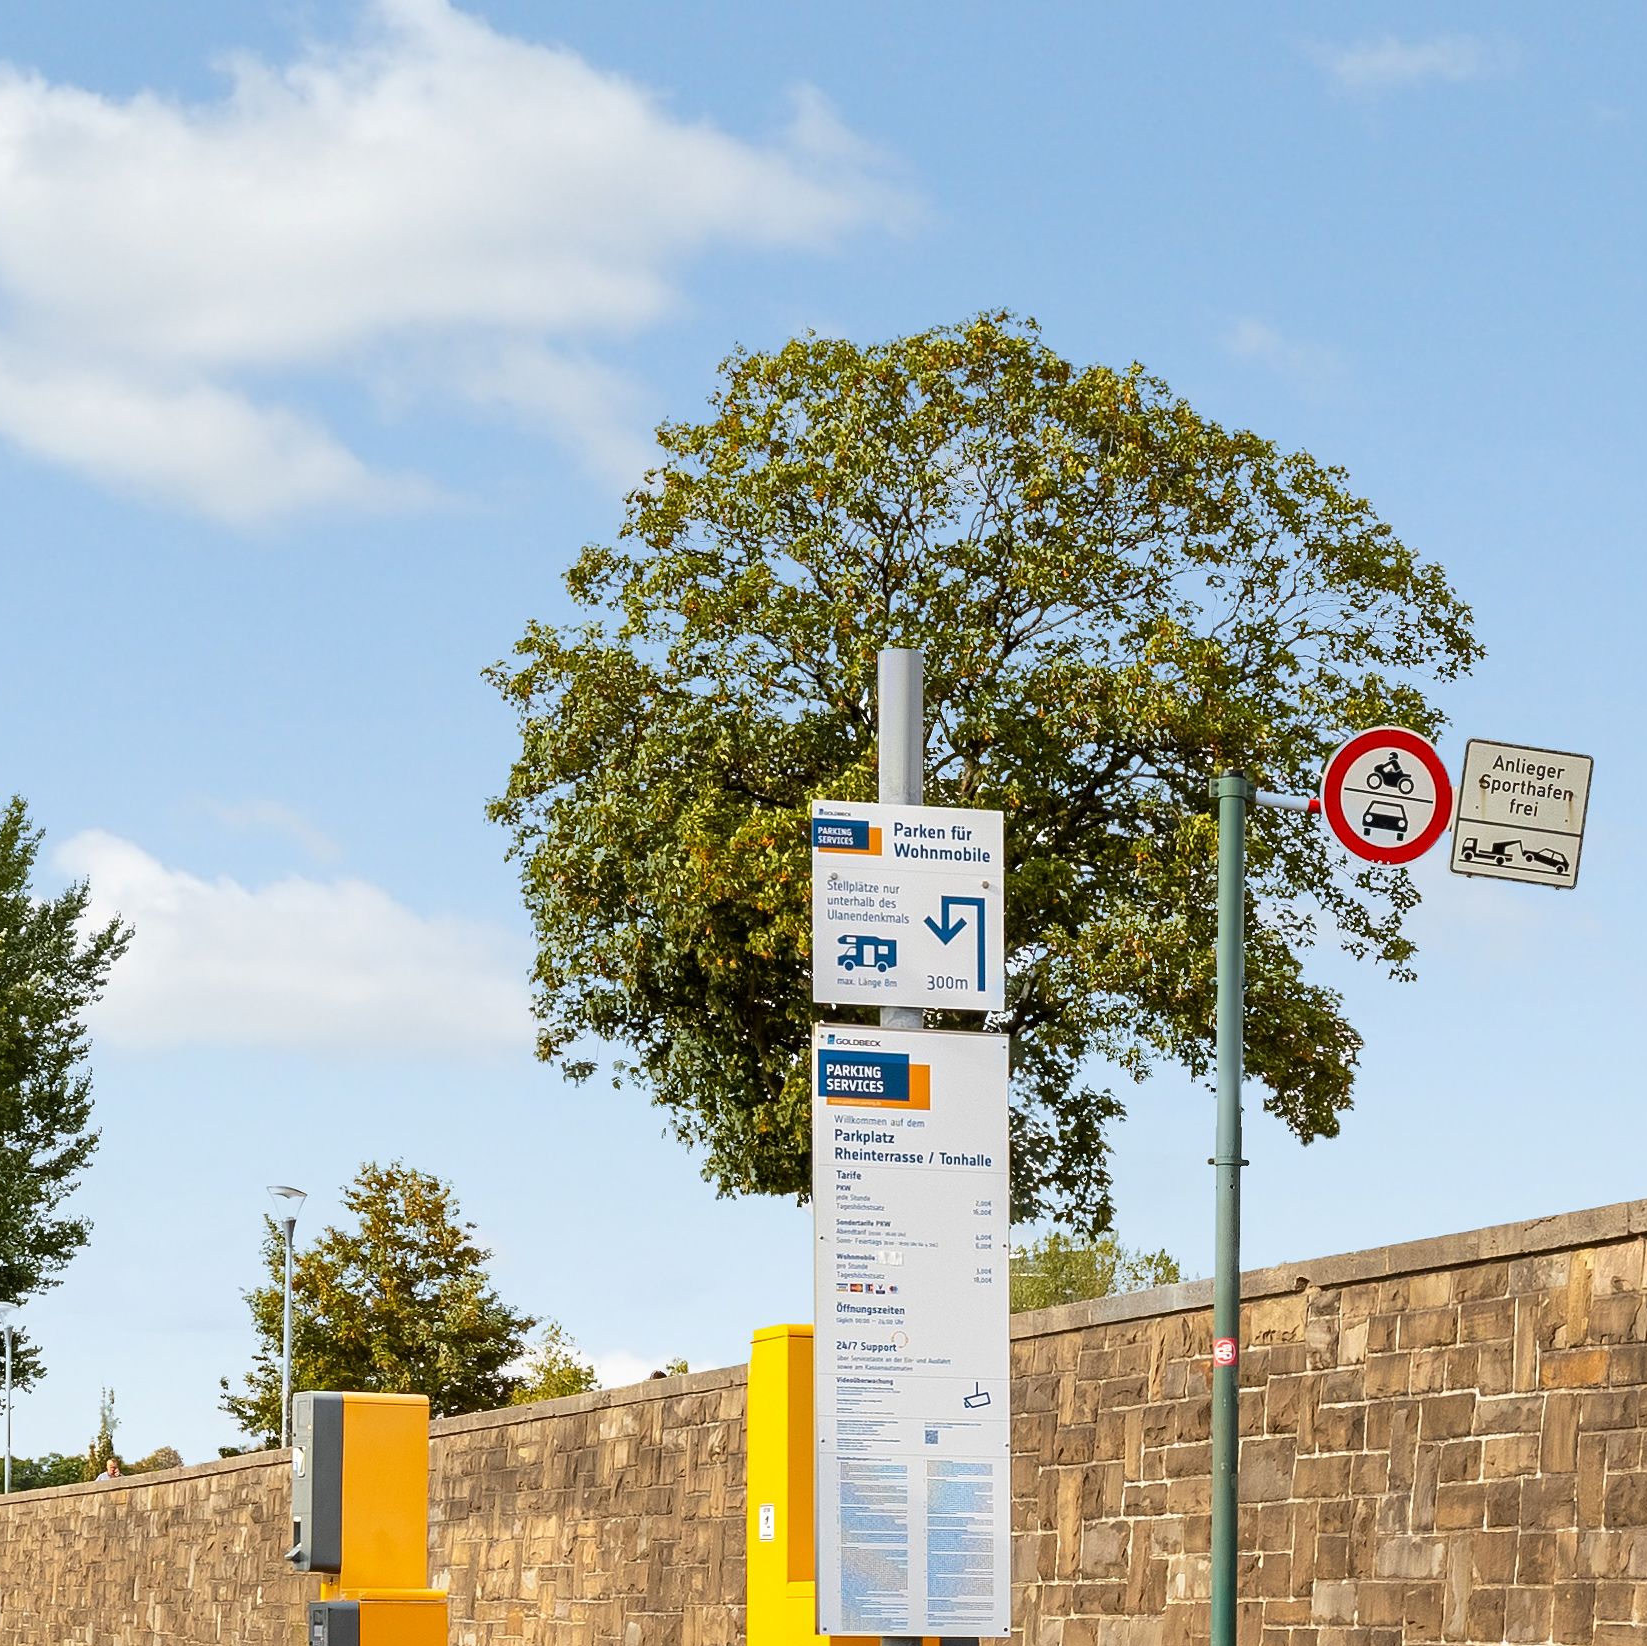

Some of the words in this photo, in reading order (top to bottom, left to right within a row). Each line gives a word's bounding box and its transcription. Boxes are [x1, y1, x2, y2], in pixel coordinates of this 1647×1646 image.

[1492, 754, 1566, 781] Anlieger
[1478, 773, 1574, 803] Sporthafen
[1509, 798, 1539, 817] frei
[817, 826, 852, 836] PARKING
[893, 822, 946, 840] Parken
[950, 825, 973, 841] für
[817, 835, 854, 846] SERVICES
[893, 842, 991, 864] Wohnmobile
[827, 880, 879, 894] Stellplätze
[883, 885, 900, 894] nur
[827, 896, 875, 907] unterhalb
[878, 897, 897, 909] des
[827, 909, 910, 924] Ulanendenkmals
[927, 975, 969, 990] 300m
[835, 1038, 881, 1047] GOLDBECK
[826, 1063, 882, 1078] PARKING
[826, 1078, 884, 1093] SERVICES
[834, 1114, 887, 1127] Willkommen
[890, 1117, 904, 1127] auf
[906, 1118, 926, 1129] dem
[834, 1128, 895, 1145] Parkplatz
[834, 1147, 924, 1164] Rheinterrasse
[928, 1152, 934, 1164] /
[939, 1151, 992, 1167] Tonhalle
[836, 1170, 862, 1180] Tarife
[836, 1253, 876, 1261] Wohnmobile
[836, 1301, 905, 1316] Öffnungszeiten
[836, 1341, 857, 1350] 24/7
[860, 1341, 897, 1353] Support
[836, 1376, 894, 1386] Videoüberwachung
